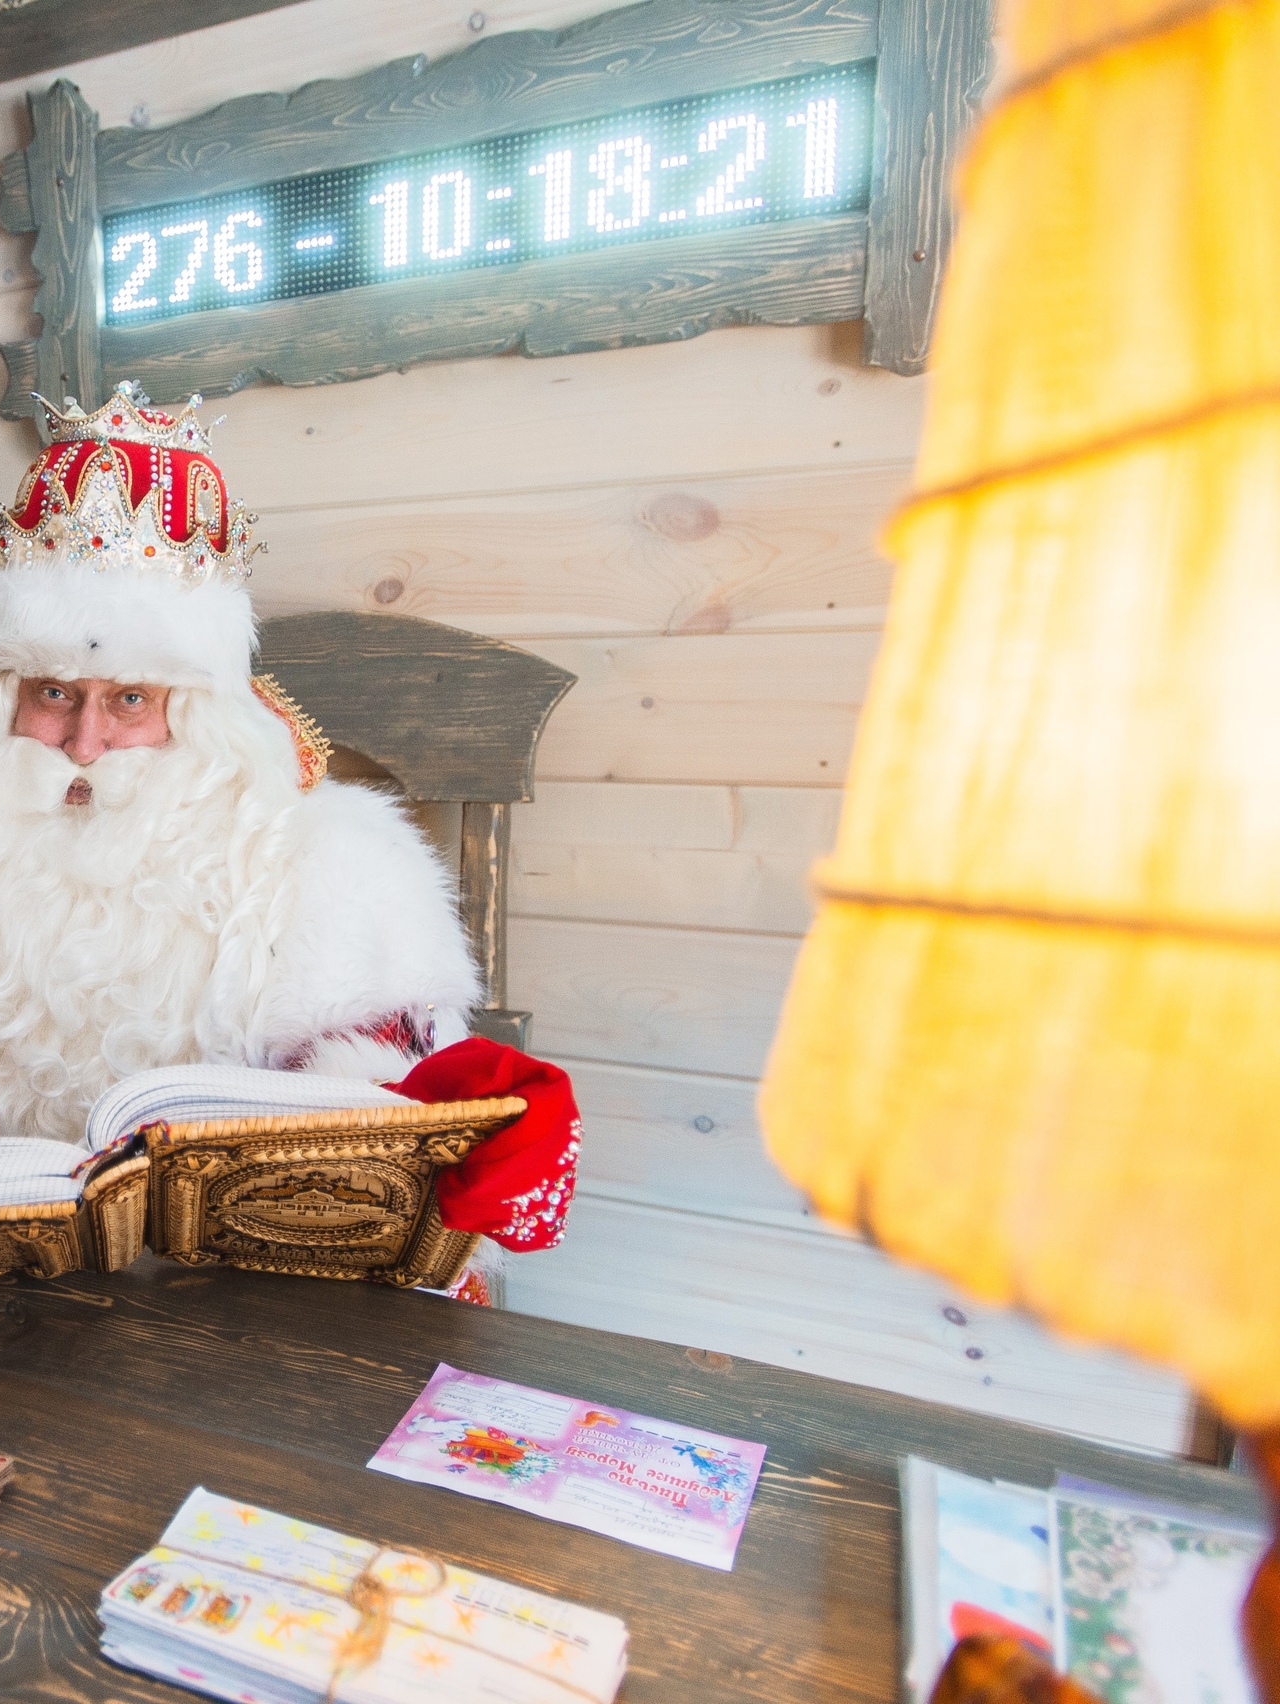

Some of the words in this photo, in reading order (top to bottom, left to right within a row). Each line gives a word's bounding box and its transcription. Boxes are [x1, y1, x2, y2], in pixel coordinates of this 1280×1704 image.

[110, 207, 265, 314] 276
[368, 96, 841, 271] 10:18:21
[564, 1446, 637, 1475] Морозу
[658, 1458, 681, 1469] от
[607, 1470, 687, 1506] Письмо
[646, 1468, 737, 1503] Дедушке
